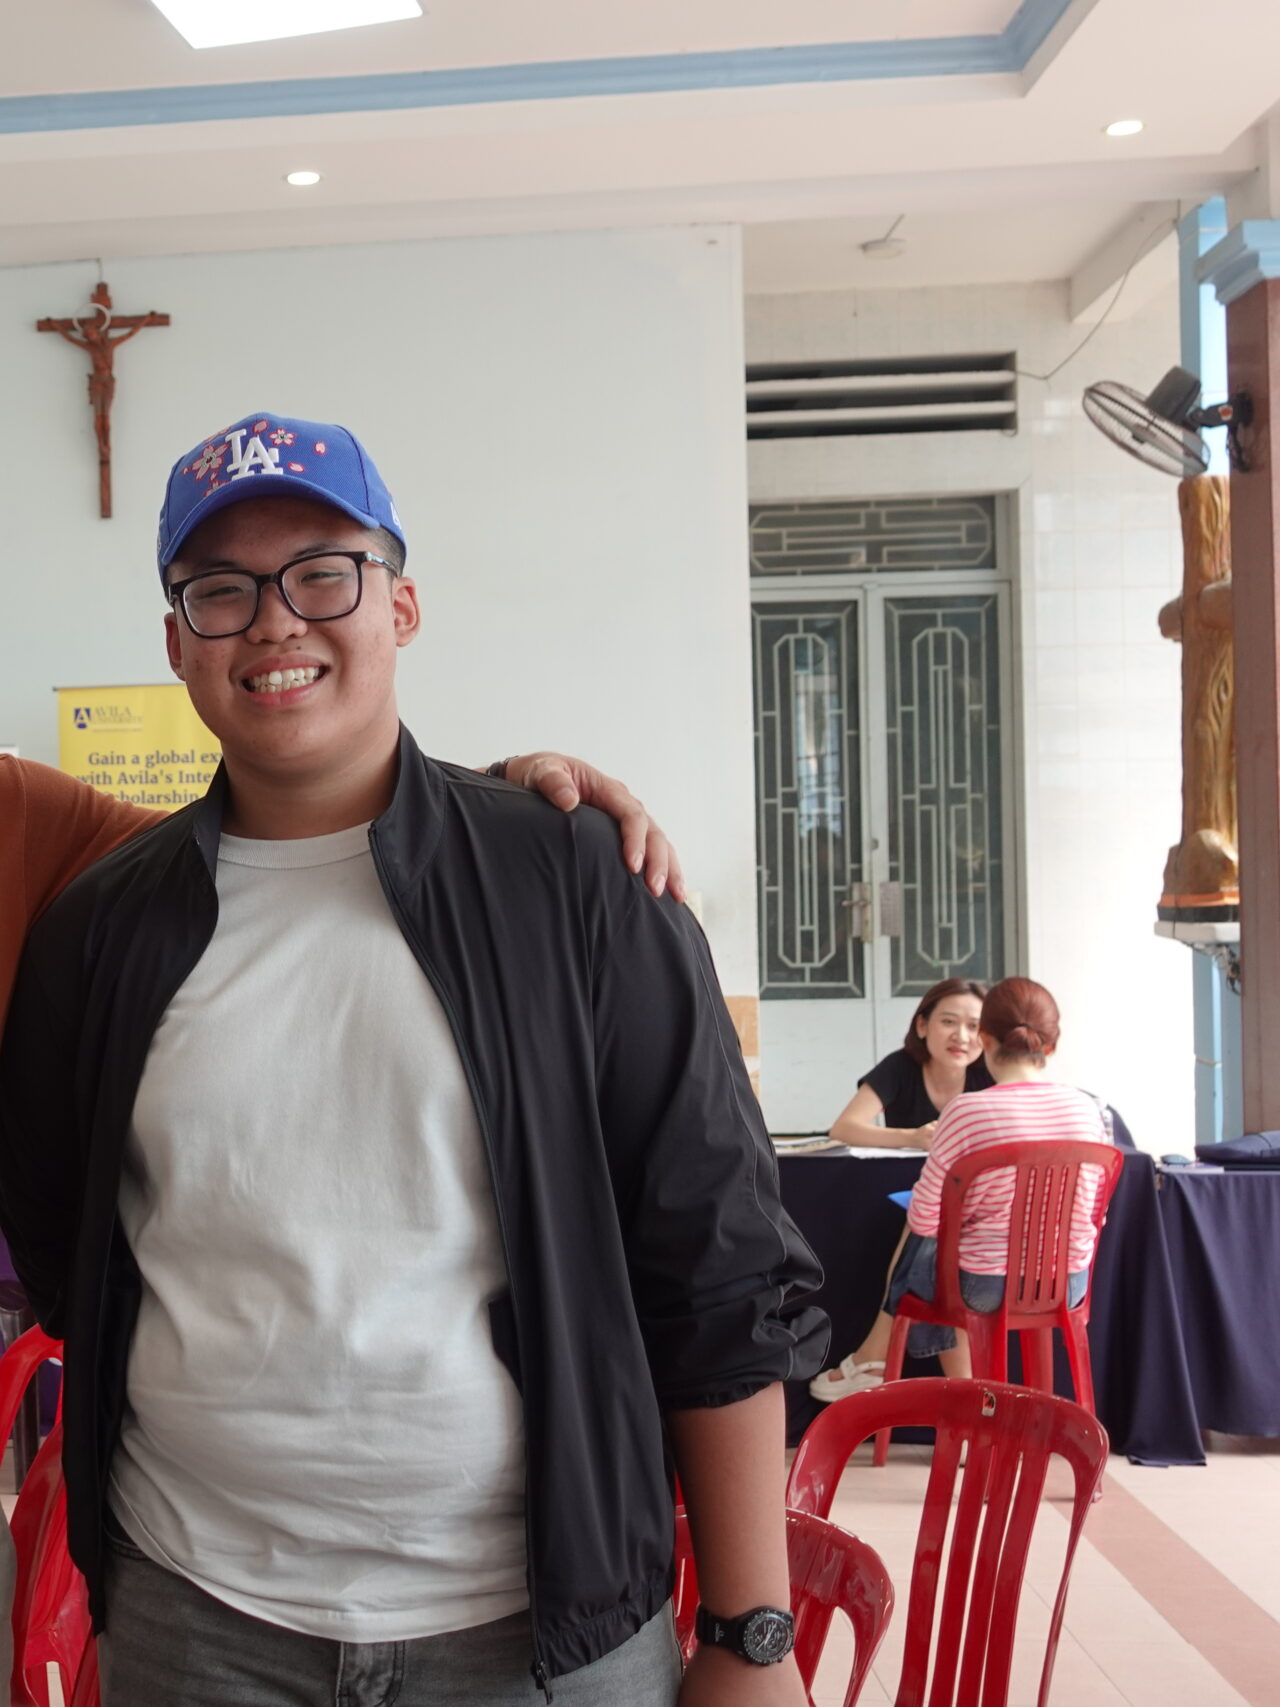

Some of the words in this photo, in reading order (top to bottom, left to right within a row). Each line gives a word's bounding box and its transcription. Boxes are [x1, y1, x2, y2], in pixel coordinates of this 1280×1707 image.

[224, 428, 284, 481] LA
[88, 751, 126, 766] Gain
[131, 753, 141, 765] a
[145, 749, 196, 769] global
[117, 769, 174, 785] Avila's
